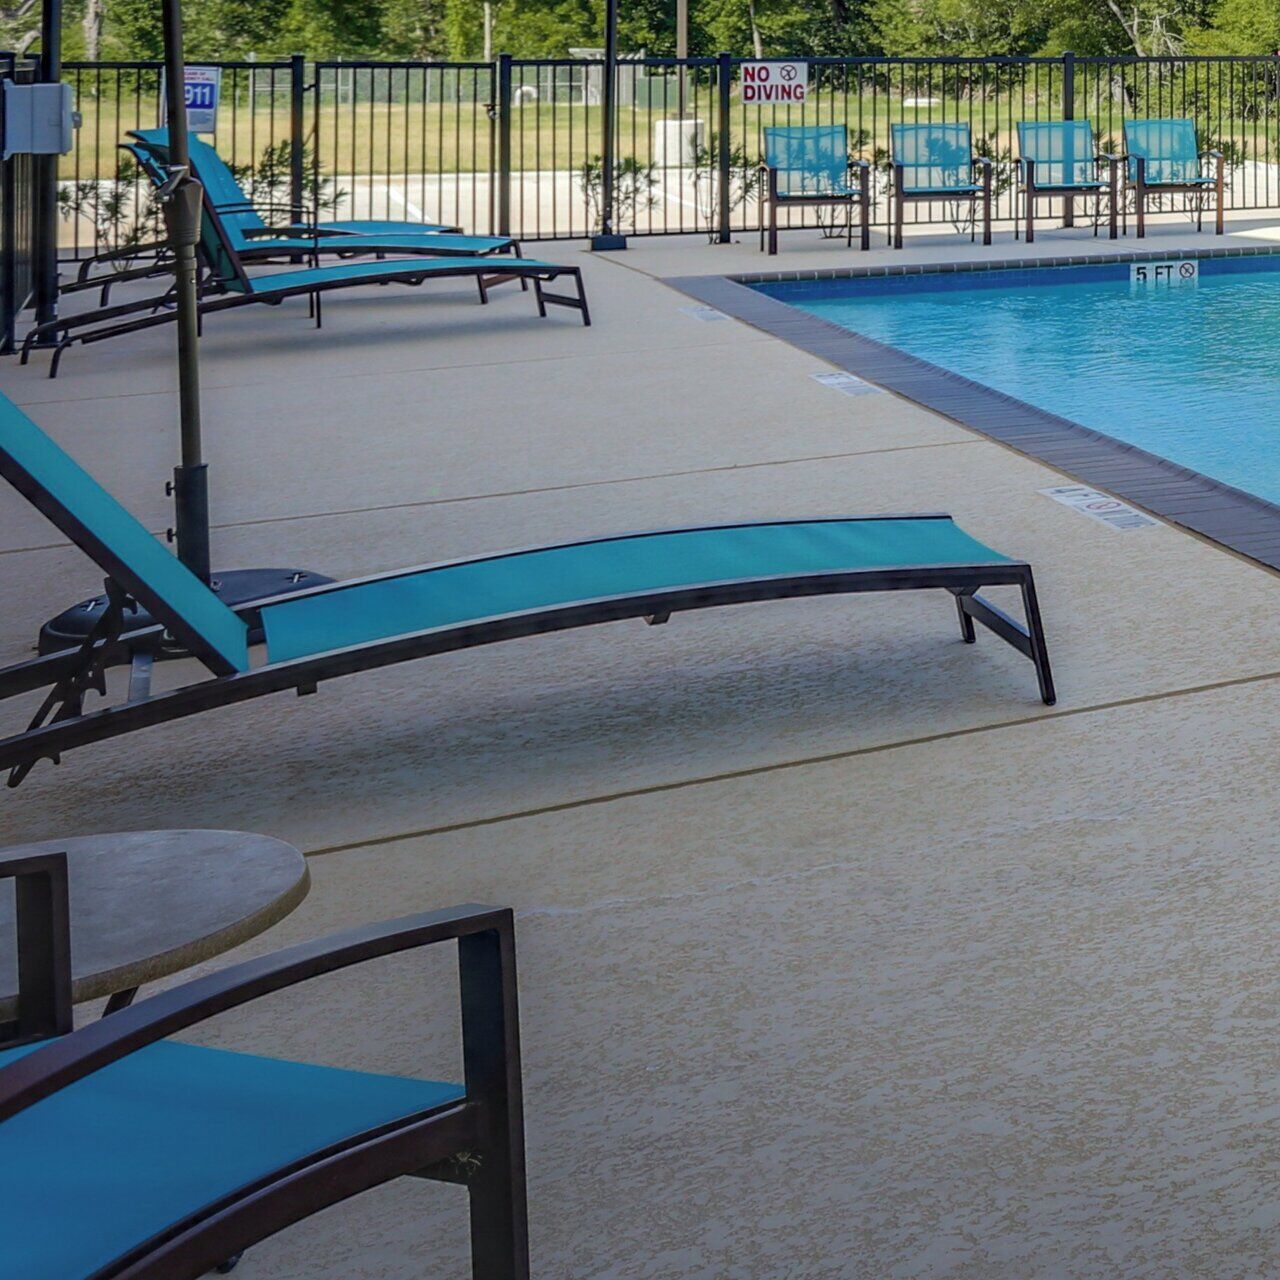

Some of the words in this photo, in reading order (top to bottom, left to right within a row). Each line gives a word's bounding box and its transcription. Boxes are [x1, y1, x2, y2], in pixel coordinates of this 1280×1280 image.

[743, 65, 770, 83] NO
[184, 85, 210, 105] 911
[743, 84, 804, 101] DIVING
[1136, 266, 1147, 281] 5
[1155, 265, 1173, 281] FT
